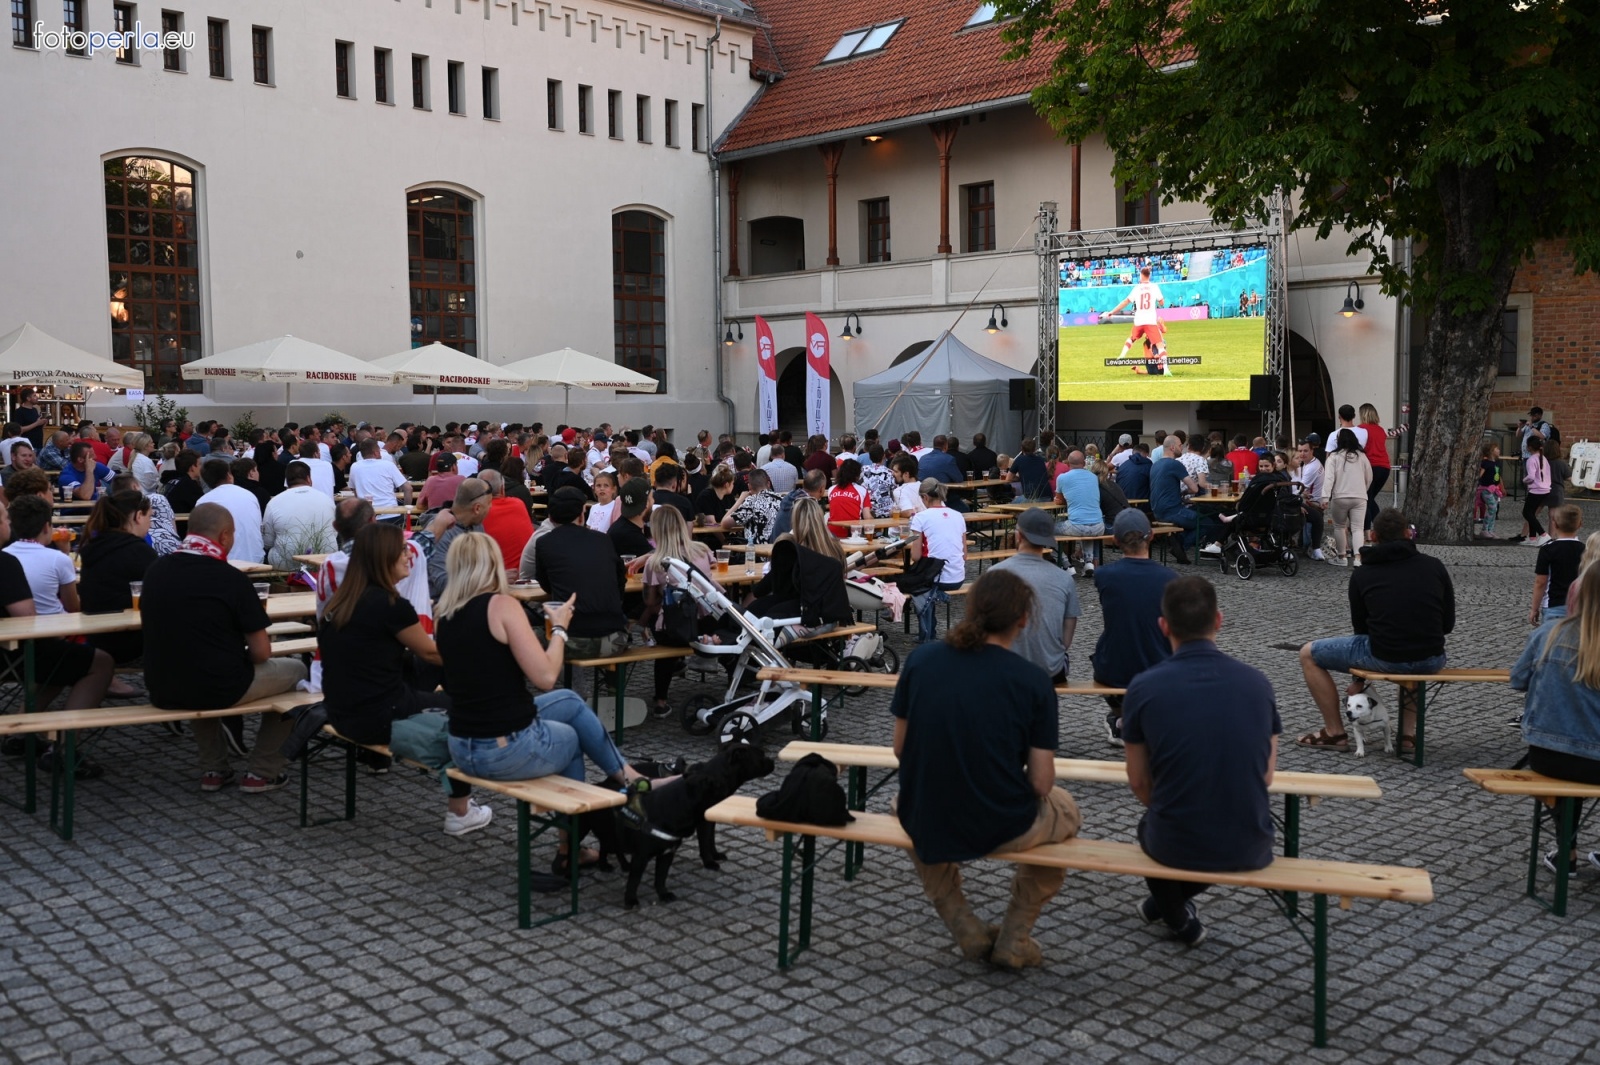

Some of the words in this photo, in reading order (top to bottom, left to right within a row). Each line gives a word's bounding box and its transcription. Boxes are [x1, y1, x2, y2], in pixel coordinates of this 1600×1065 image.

[1140, 292, 1151, 310] 13
[1105, 358, 1147, 366] Lewandowski
[13, 369, 54, 380] BROWAR
[204, 367, 237, 377] RACIBORSKIE
[306, 371, 357, 381] RACIBORSKIE
[439, 375, 491, 385] RACIBORSKIE
[829, 490, 860, 501] POLSKA
